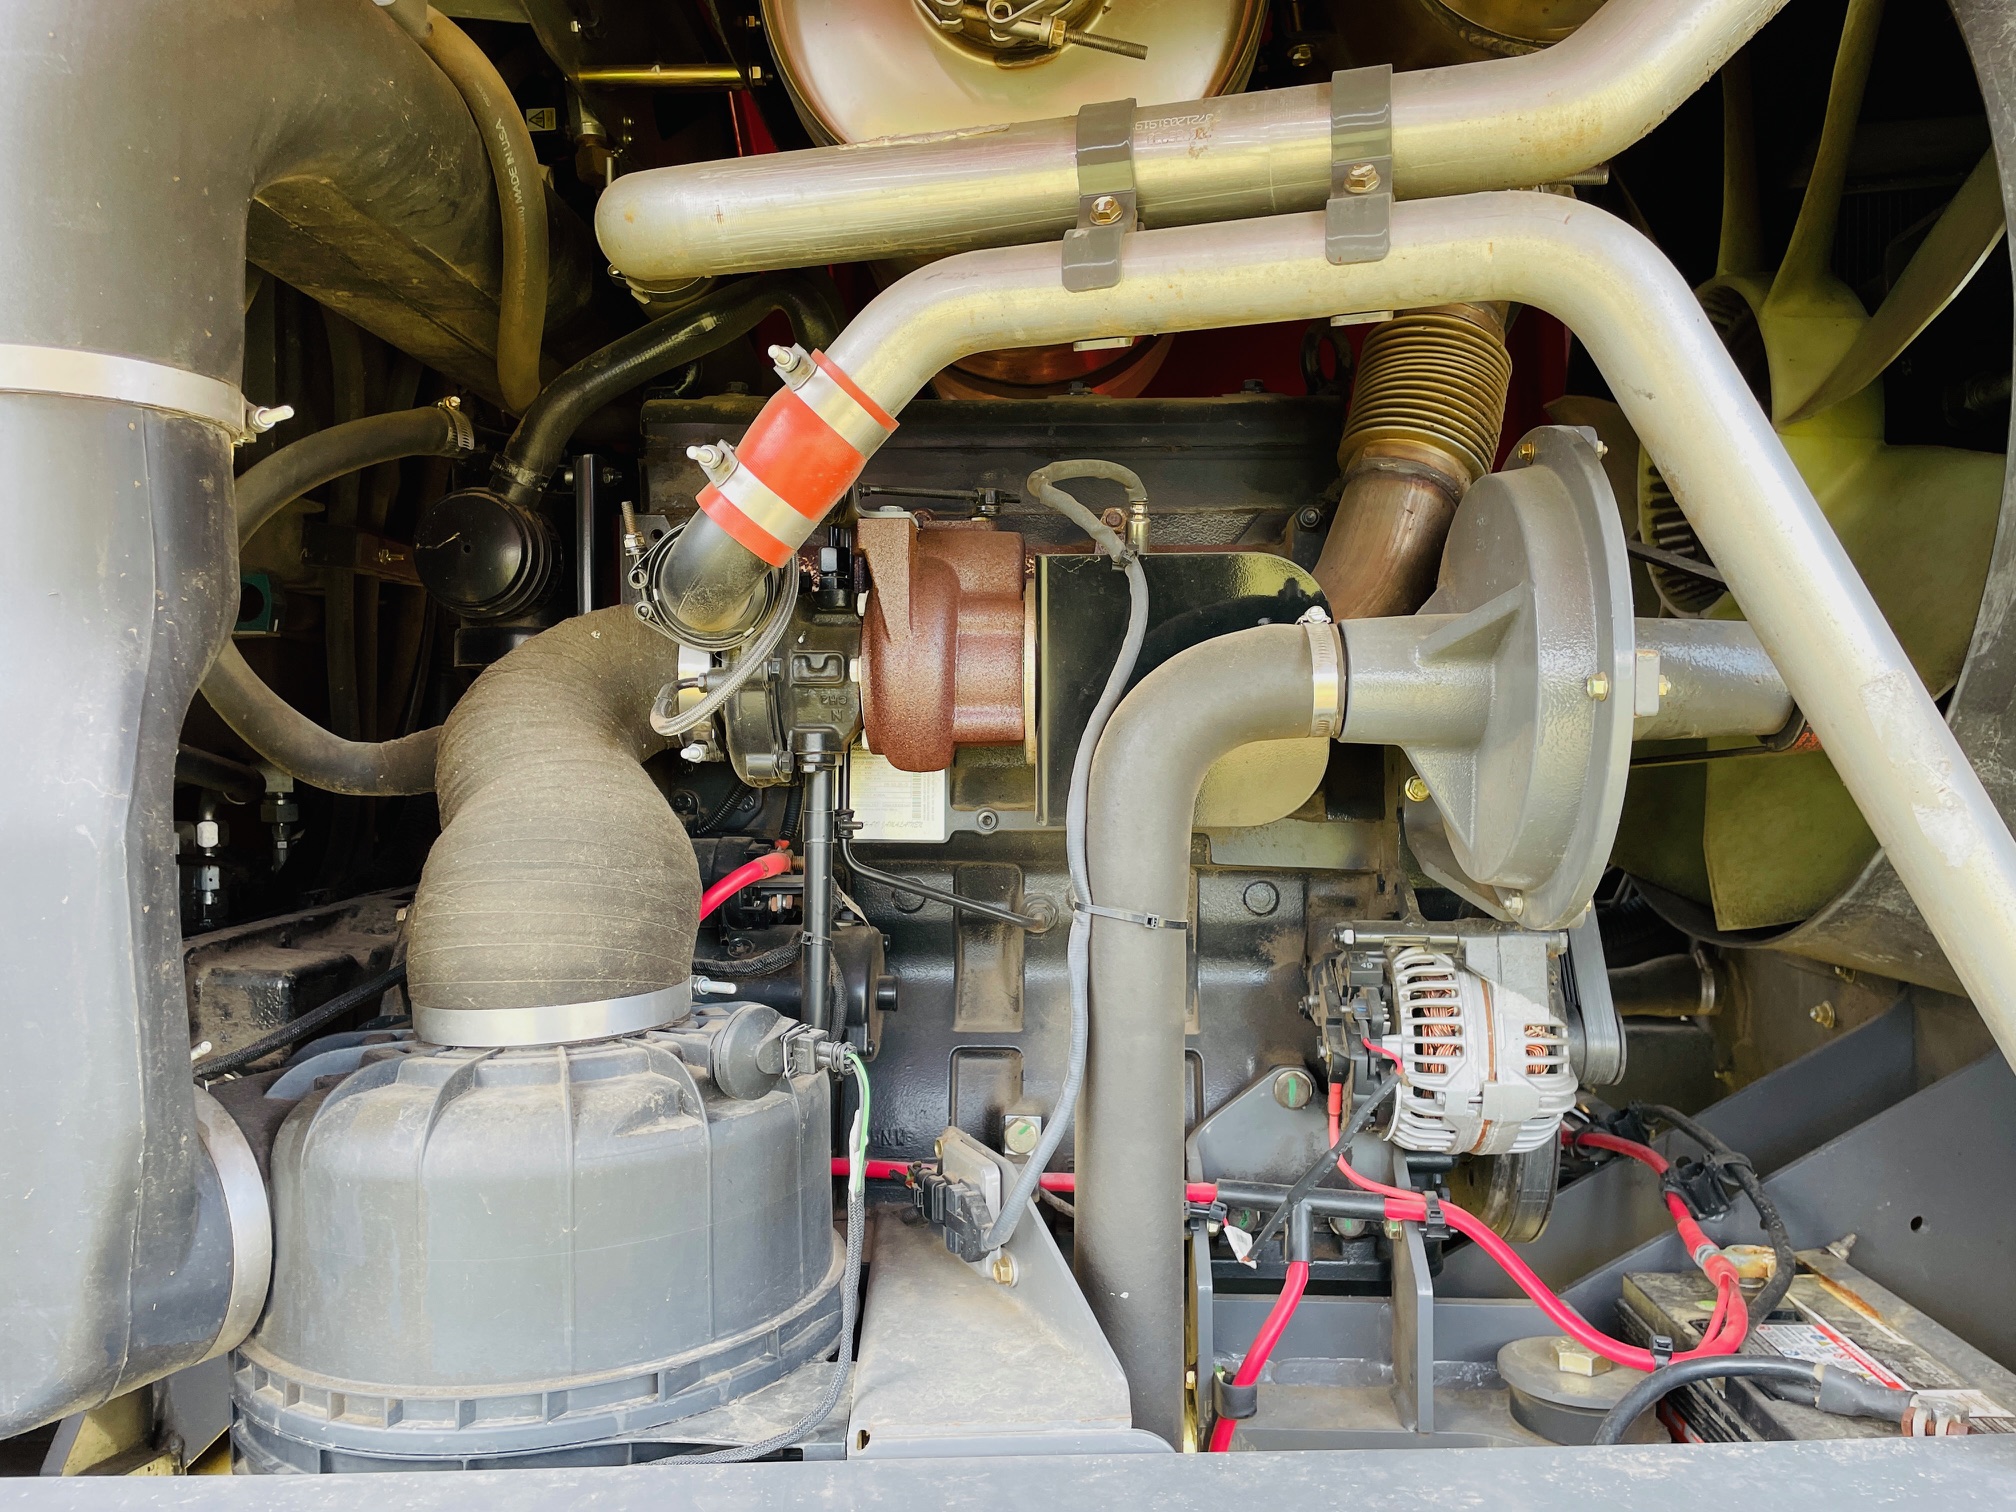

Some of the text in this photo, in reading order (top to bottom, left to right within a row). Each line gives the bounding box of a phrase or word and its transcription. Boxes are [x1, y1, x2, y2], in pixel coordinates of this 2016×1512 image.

[495, 117, 511, 151] USA
[504, 151, 515, 166] IN
[508, 166, 523, 204] MADE
